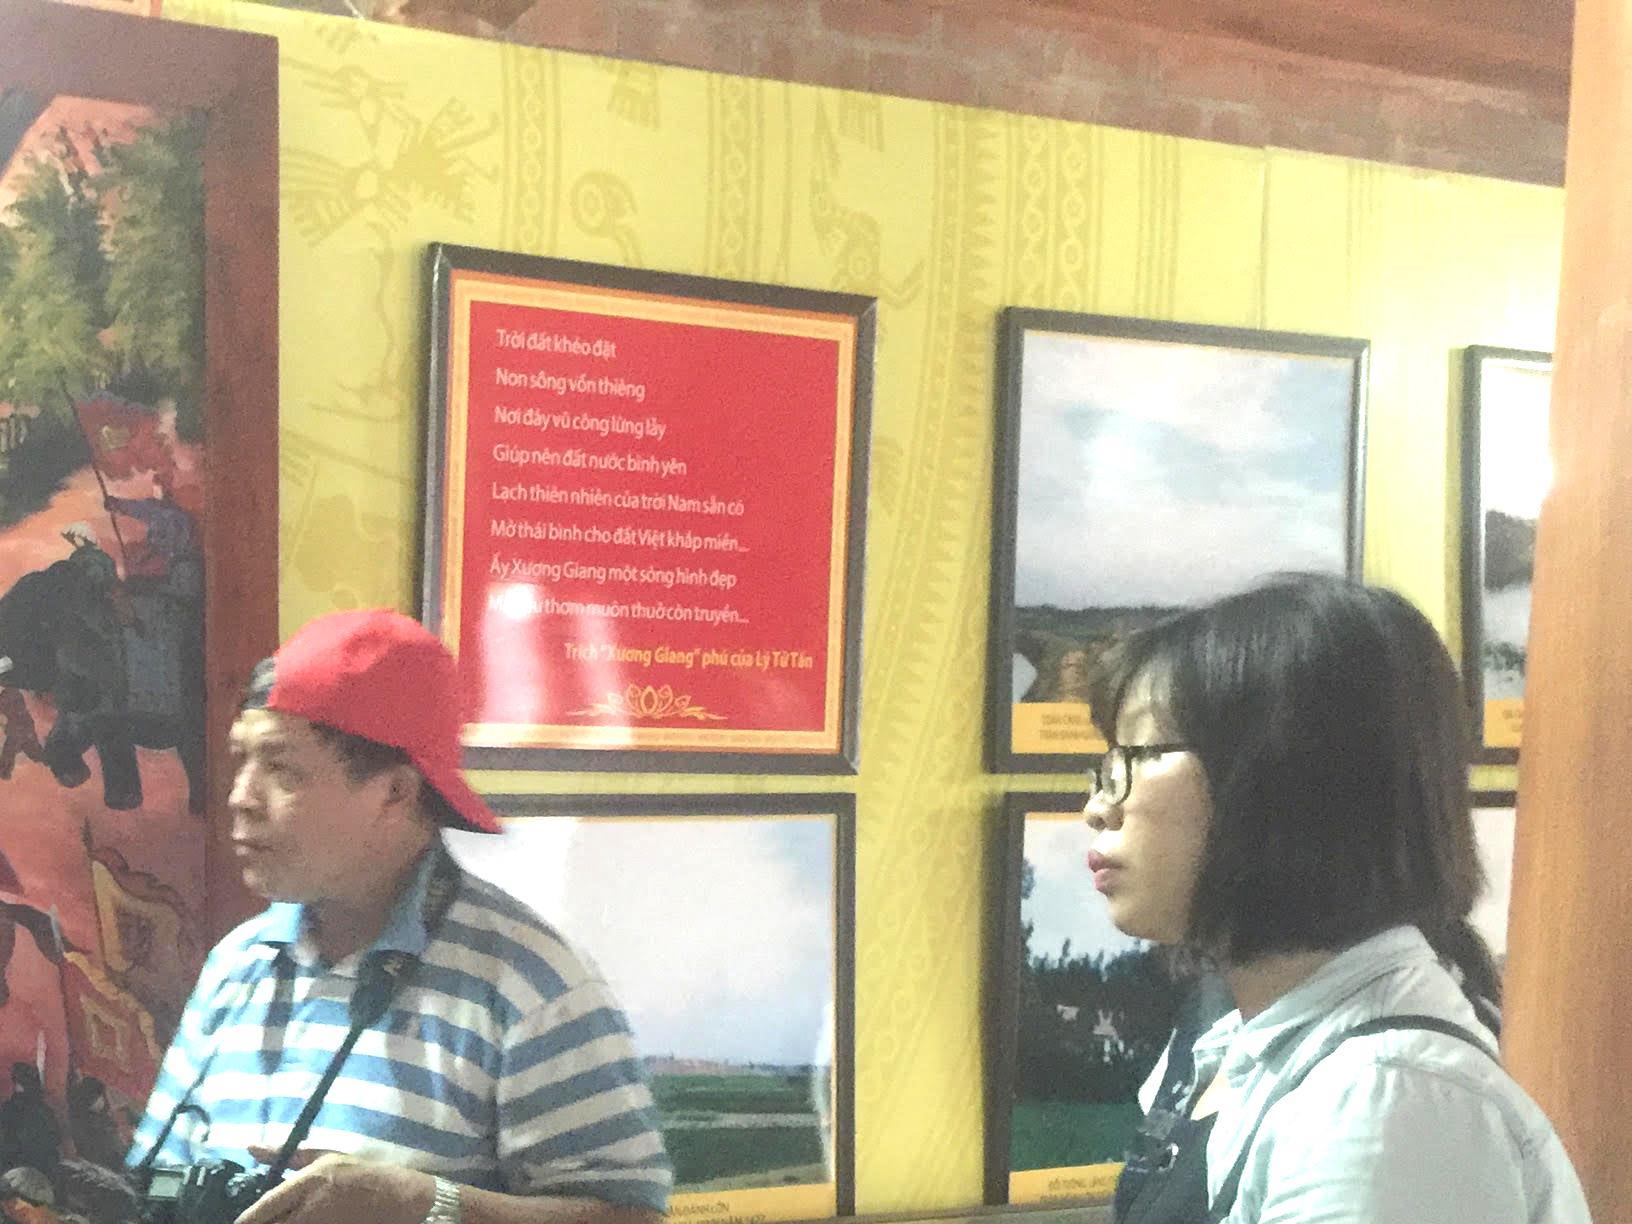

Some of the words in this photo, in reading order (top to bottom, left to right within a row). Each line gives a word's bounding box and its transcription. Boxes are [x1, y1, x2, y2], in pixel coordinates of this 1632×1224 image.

[496, 328, 525, 349] Trời
[526, 331, 552, 351] đất
[554, 333, 591, 354] khéo
[592, 338, 616, 361] đặt
[496, 367, 527, 387] Non
[530, 370, 566, 395] sông
[568, 373, 596, 393] vốn
[598, 376, 645, 402] thiêng
[494, 405, 521, 425] Nơi
[572, 412, 609, 437] công
[493, 444, 529, 467] Giúp
[532, 448, 560, 465] nên
[562, 448, 587, 468] đất
[589, 453, 625, 471] nước
[627, 453, 659, 474] bình
[662, 457, 687, 478] yên
[529, 484, 568, 503] thiên
[570, 487, 612, 506] nhiên
[614, 490, 639, 508] của
[641, 492, 666, 510] trời
[668, 493, 700, 513] Nam
[518, 521, 546, 539] thái
[549, 522, 581, 541] bình
[584, 525, 612, 543] cho
[612, 527, 636, 545] đất
[638, 529, 666, 550] Việt
[668, 530, 702, 552] khắp
[490, 554, 509, 580] Ấy
[511, 558, 561, 582] Xương
[563, 561, 606, 584] Giang
[608, 565, 638, 585] một
[710, 568, 737, 590] đẹp
[546, 598, 584, 616] thơm
[585, 600, 629, 618] muôn
[667, 603, 692, 620] còn
[702, 648, 728, 669] phú
[730, 648, 753, 667] của
[756, 649, 770, 672] Lý
